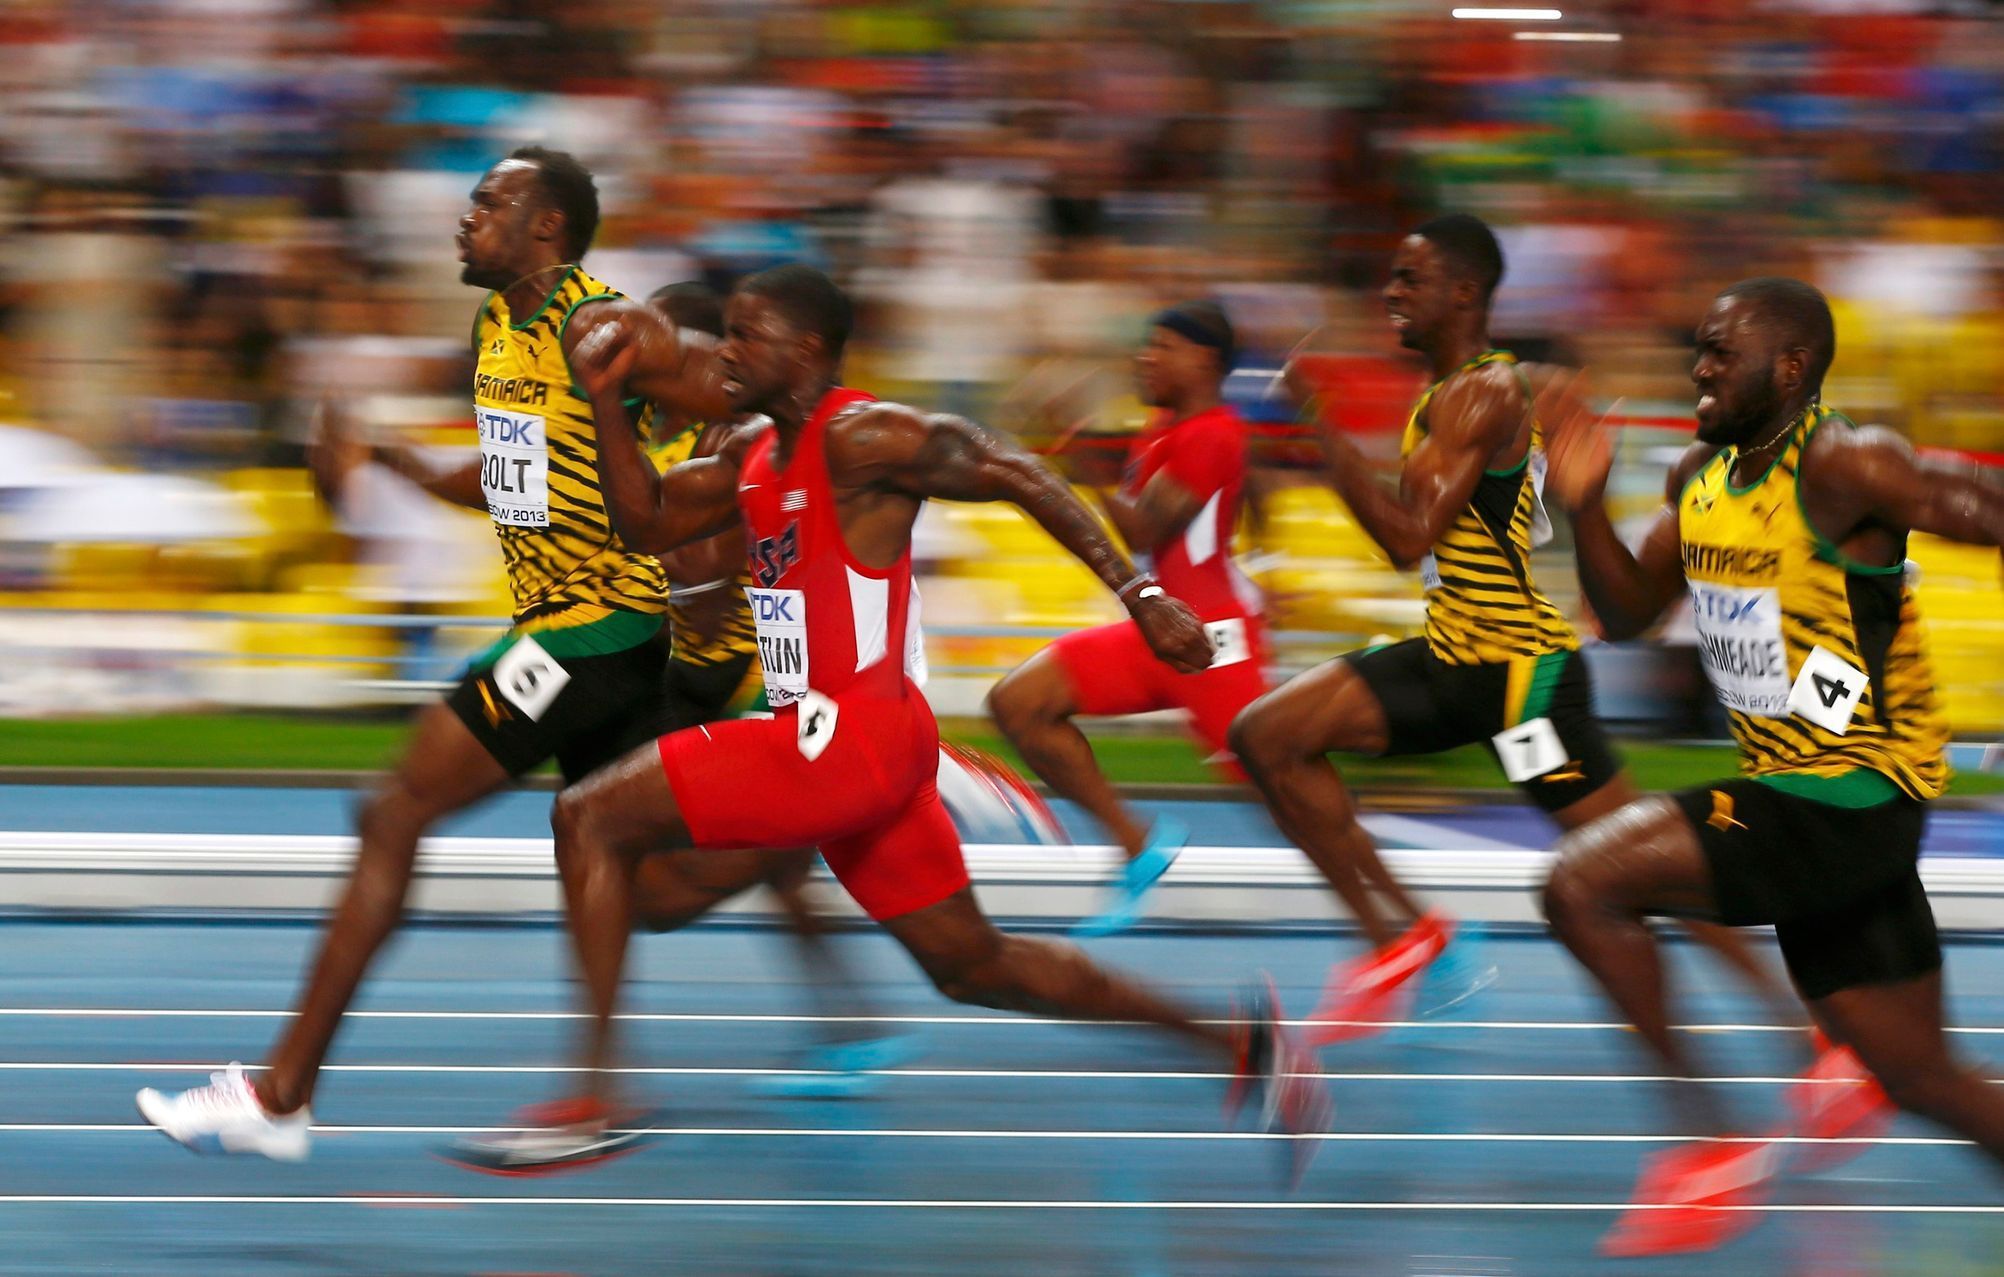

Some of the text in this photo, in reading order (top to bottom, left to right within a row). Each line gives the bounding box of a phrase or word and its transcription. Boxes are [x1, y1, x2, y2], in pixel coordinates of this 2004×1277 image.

[486, 414, 538, 445] TDK
[482, 452, 532, 493] BOLT
[513, 510, 546, 522] 2013
[752, 593, 794, 621] TDK
[1700, 590, 1764, 625] TDK
[759, 636, 801, 674] TLIN
[510, 663, 549, 698] 6
[1811, 672, 1850, 708] 4
[1512, 733, 1540, 769] 7
